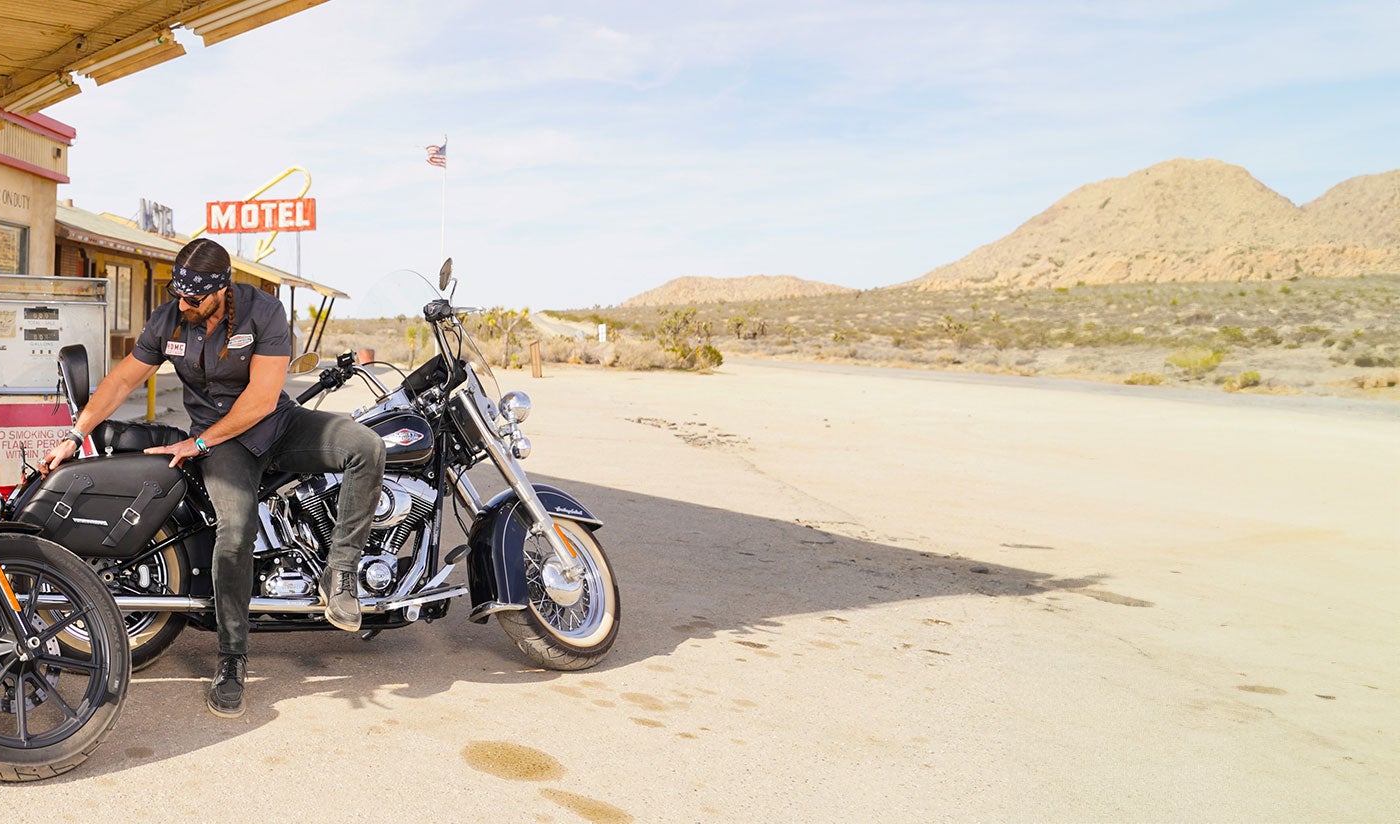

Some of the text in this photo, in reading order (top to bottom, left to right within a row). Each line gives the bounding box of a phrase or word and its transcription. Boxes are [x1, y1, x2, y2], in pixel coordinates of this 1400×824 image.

[2, 190, 13, 206] ON
[14, 192, 31, 210] DUTY
[139, 198, 176, 238] MOTEL
[210, 201, 310, 230] MOTEL
[8, 429, 54, 439] SMOKING
[1, 440, 33, 450] FLAME
